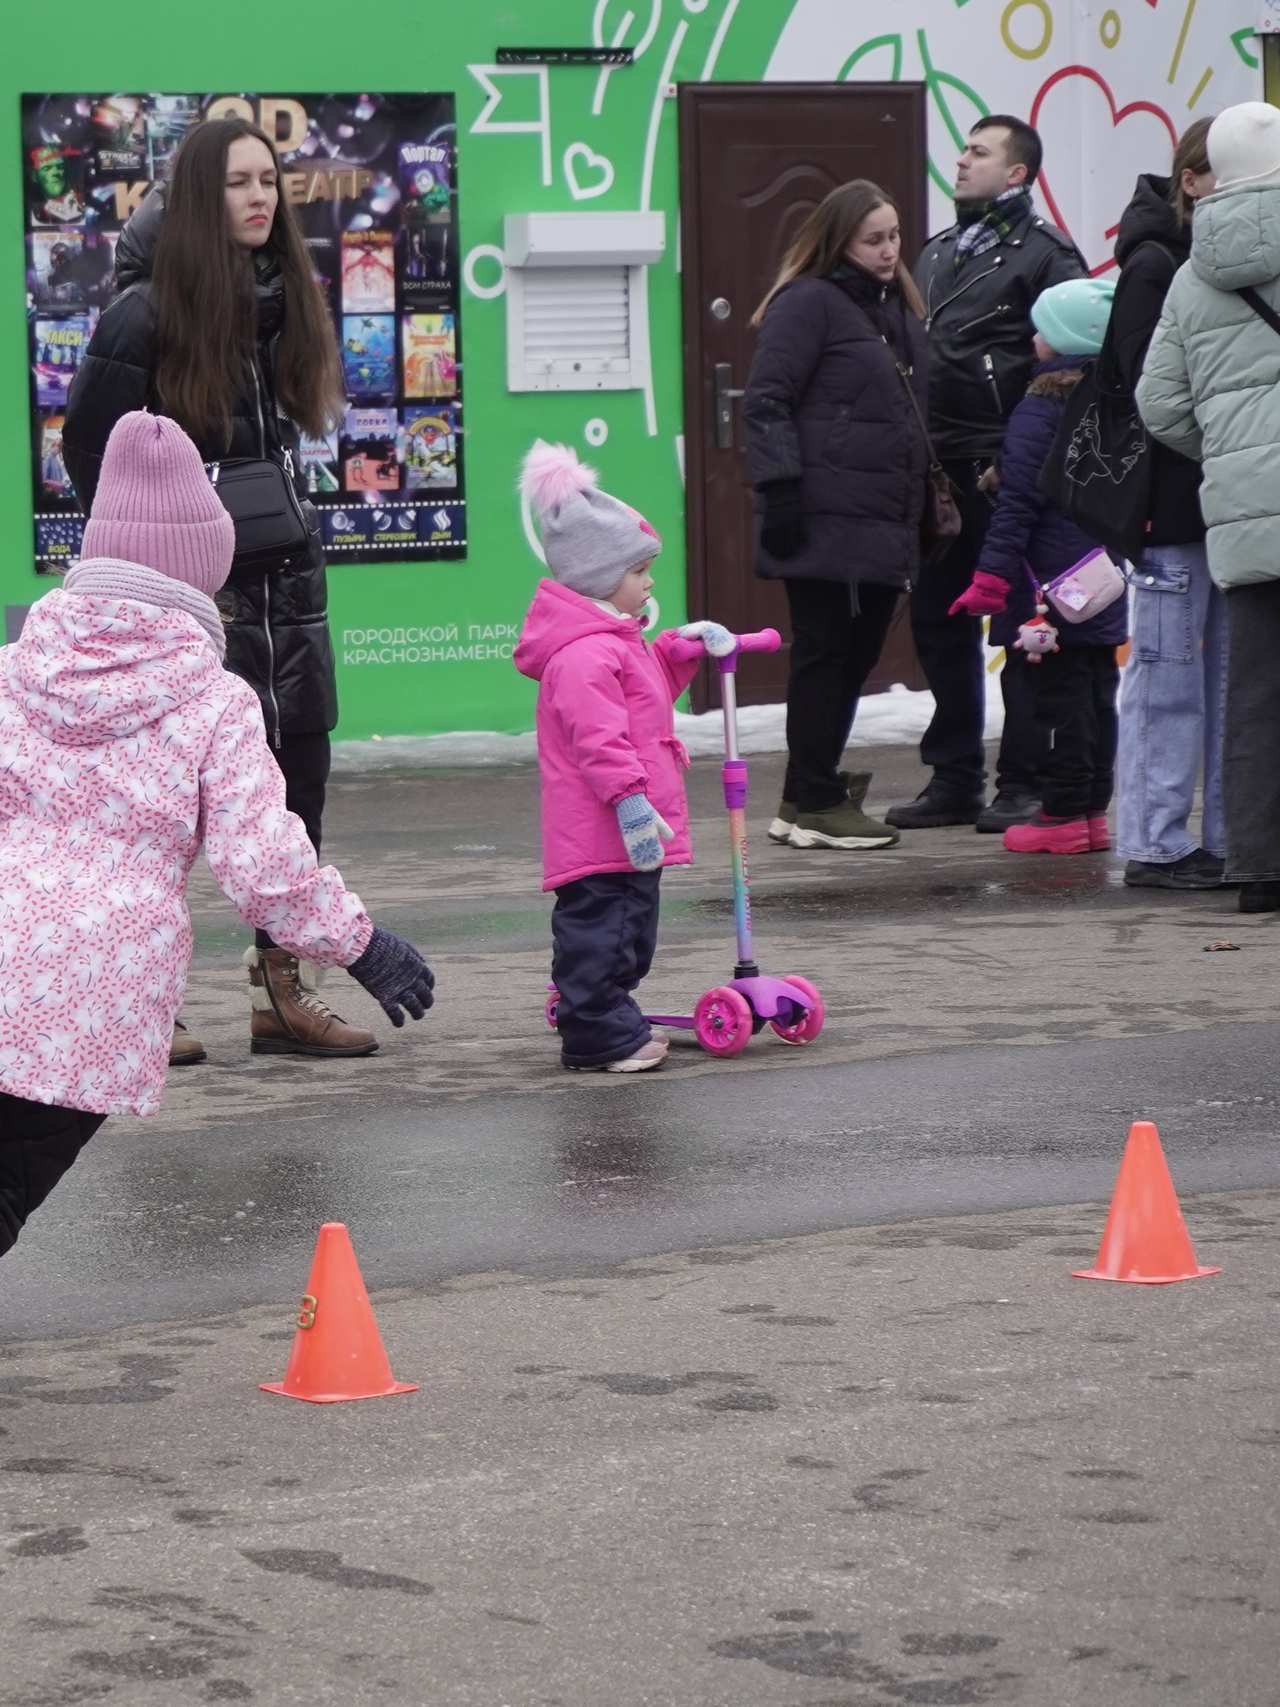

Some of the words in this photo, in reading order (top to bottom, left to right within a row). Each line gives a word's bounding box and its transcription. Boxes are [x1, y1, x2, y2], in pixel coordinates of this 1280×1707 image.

[401, 146, 447, 164] Портал
[422, 280, 452, 289] СТРАХА
[45, 329, 84, 346] ТАКСИ
[333, 535, 366, 543] ПУЗЫРИ
[431, 532, 452, 540] ДЫМ
[48, 546, 70, 554] ВОДА
[343, 624, 458, 646] ГОРОДСКОЙ
[469, 624, 518, 640] ПАРК
